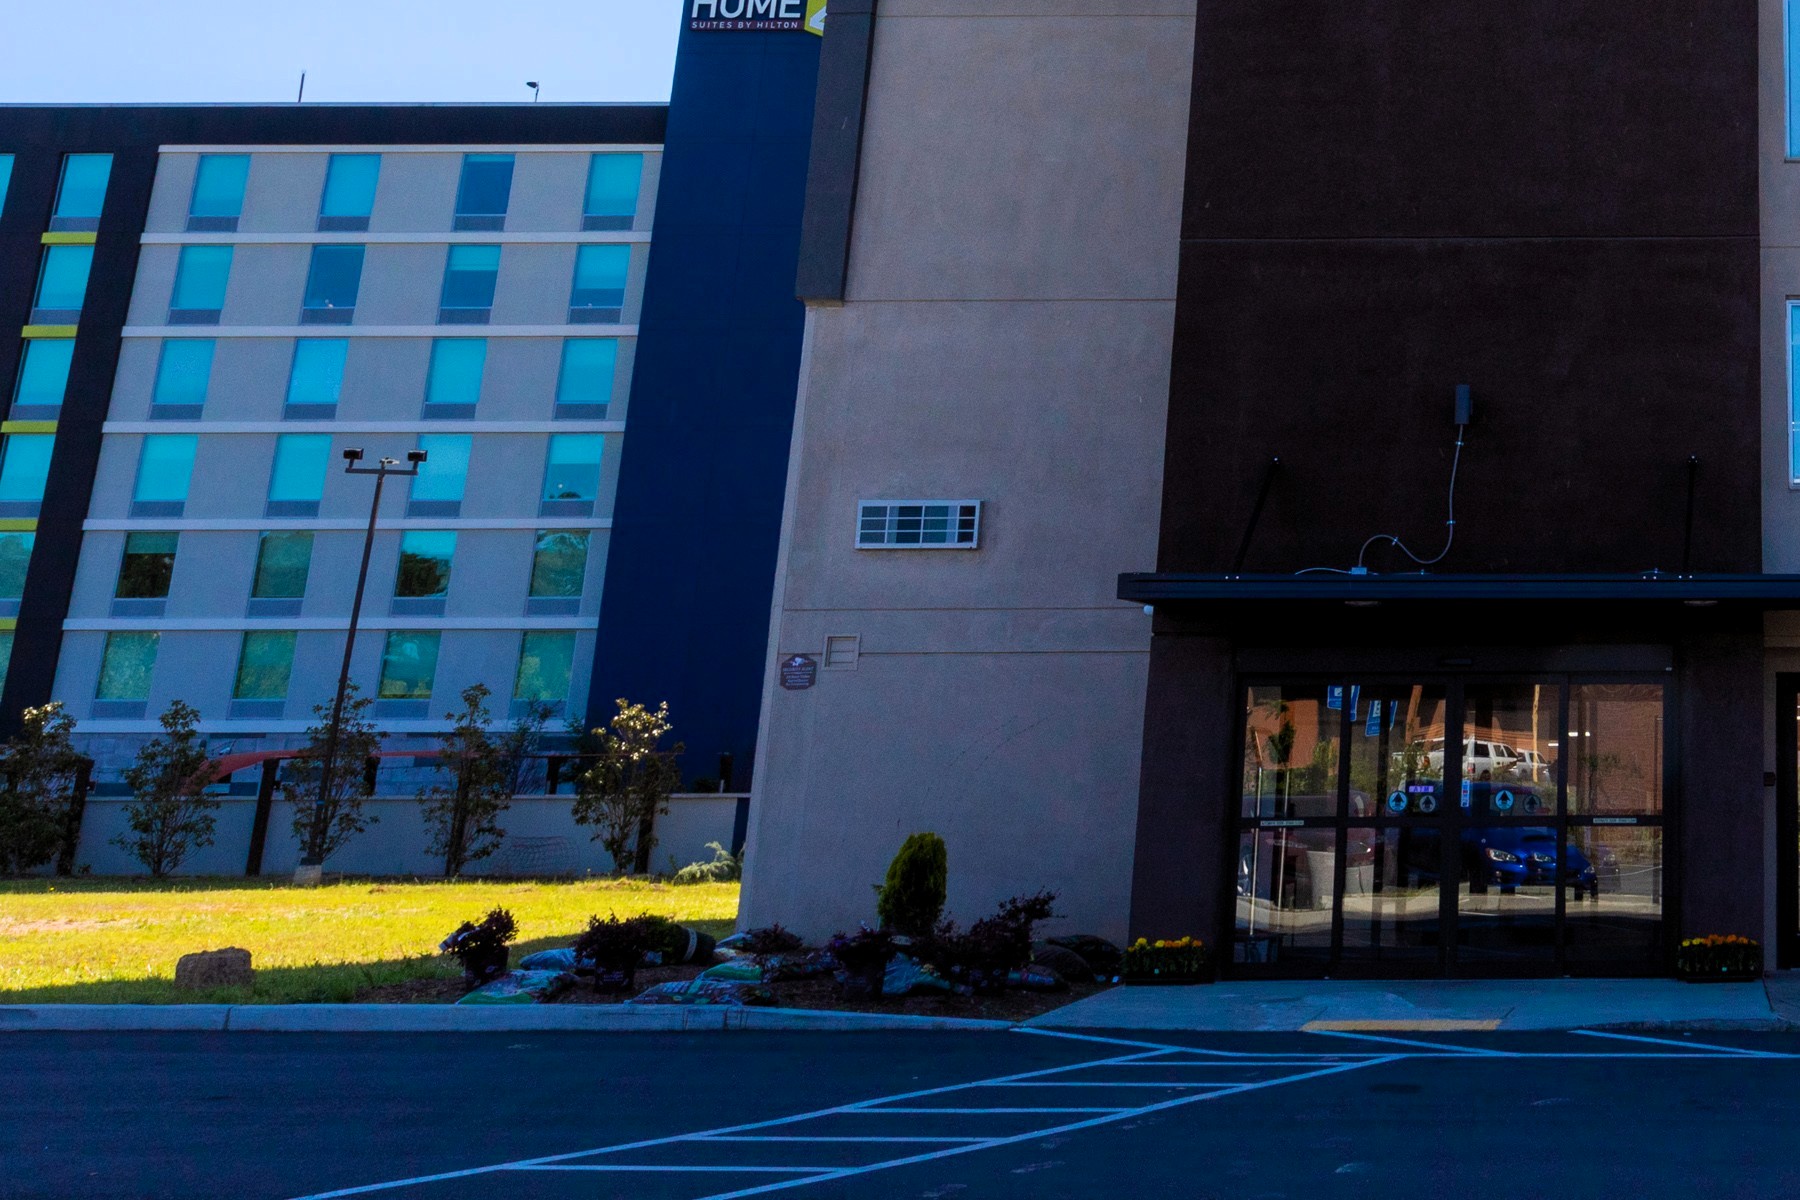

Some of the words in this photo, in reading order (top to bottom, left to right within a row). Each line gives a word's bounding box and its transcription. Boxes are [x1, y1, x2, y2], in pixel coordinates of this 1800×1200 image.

[692, 21, 732, 29] SUITES
[738, 21, 751, 29] BY
[757, 21, 798, 29] HILTON
